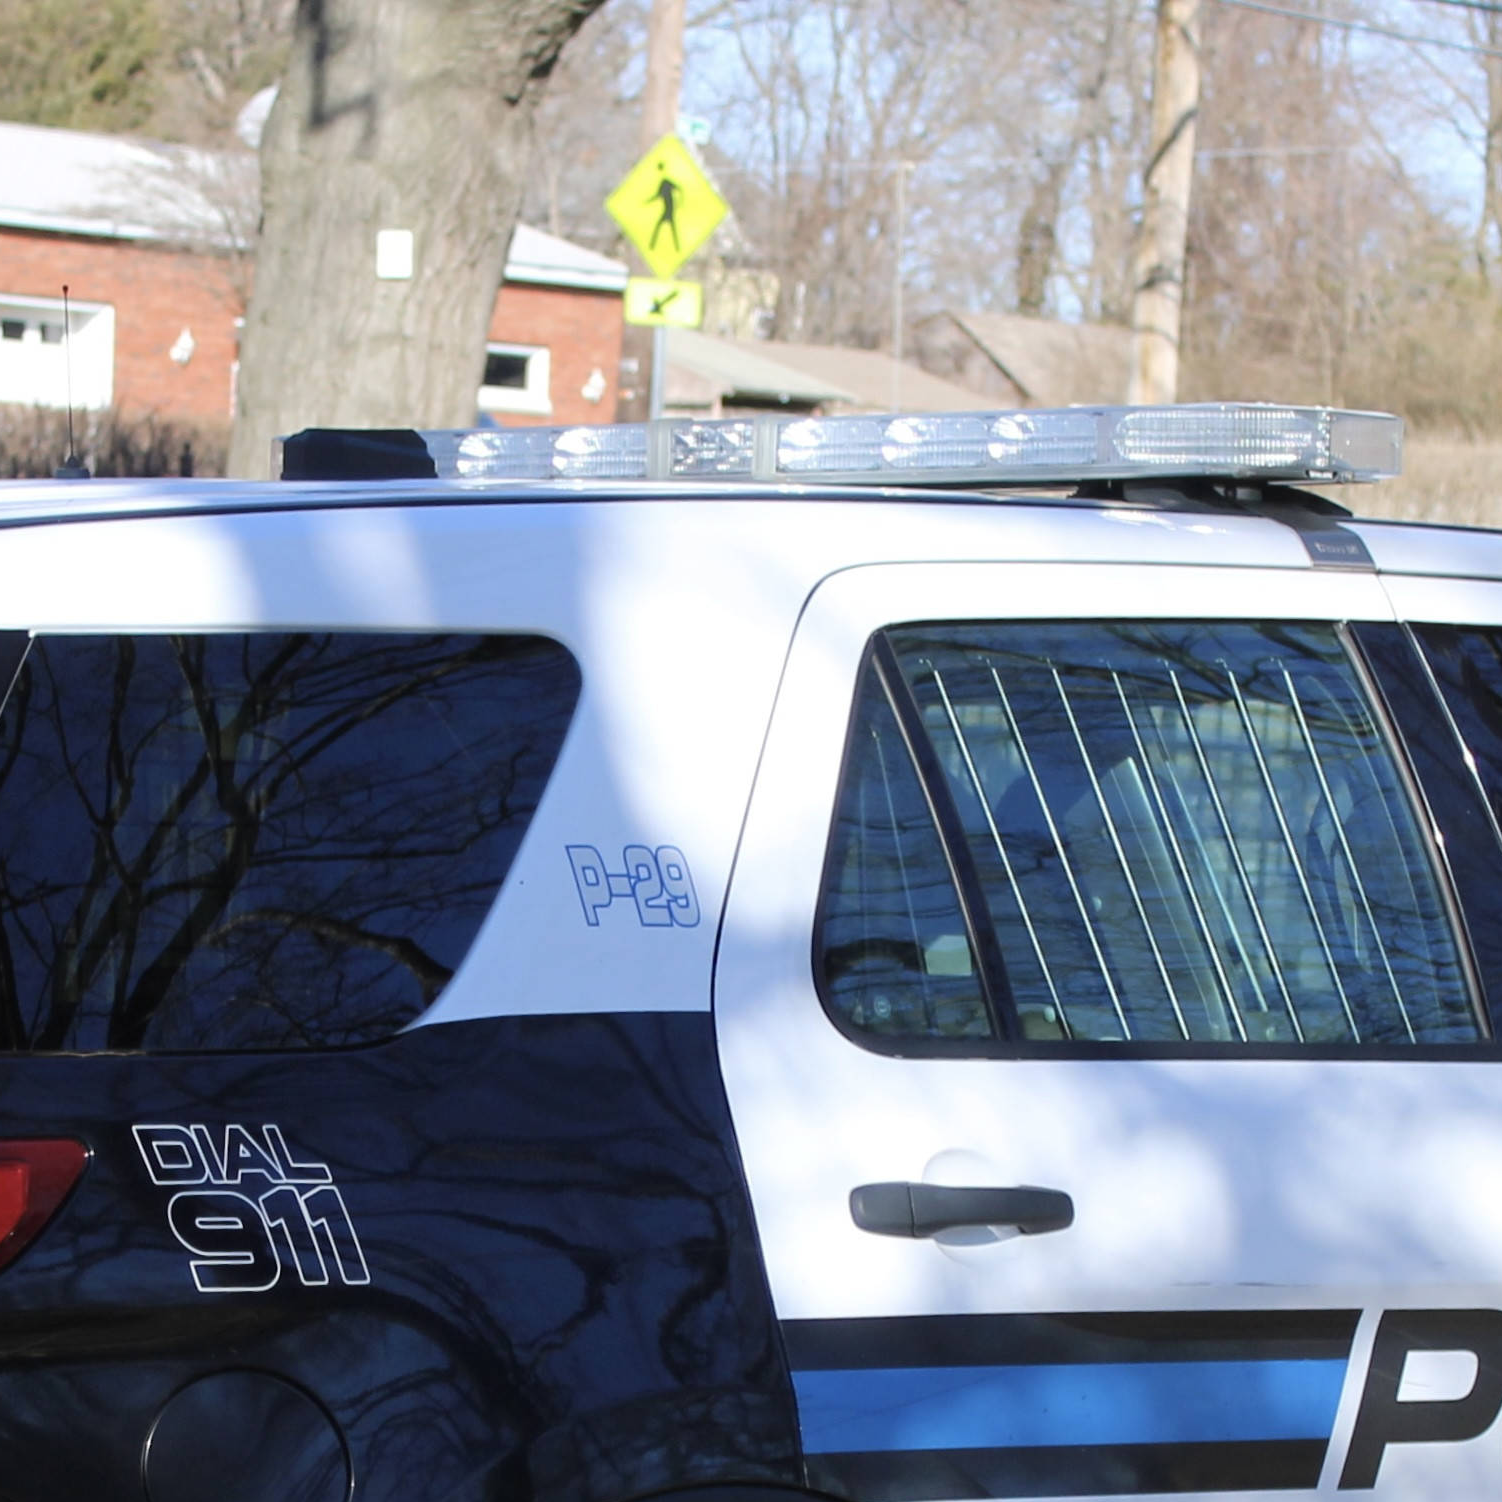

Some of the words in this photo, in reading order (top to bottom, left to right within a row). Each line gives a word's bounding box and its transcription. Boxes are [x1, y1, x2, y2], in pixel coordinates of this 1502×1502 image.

[565, 845, 700, 928] P-29
[132, 1124, 332, 1185] DIAL
[167, 1185, 371, 1292] 911
